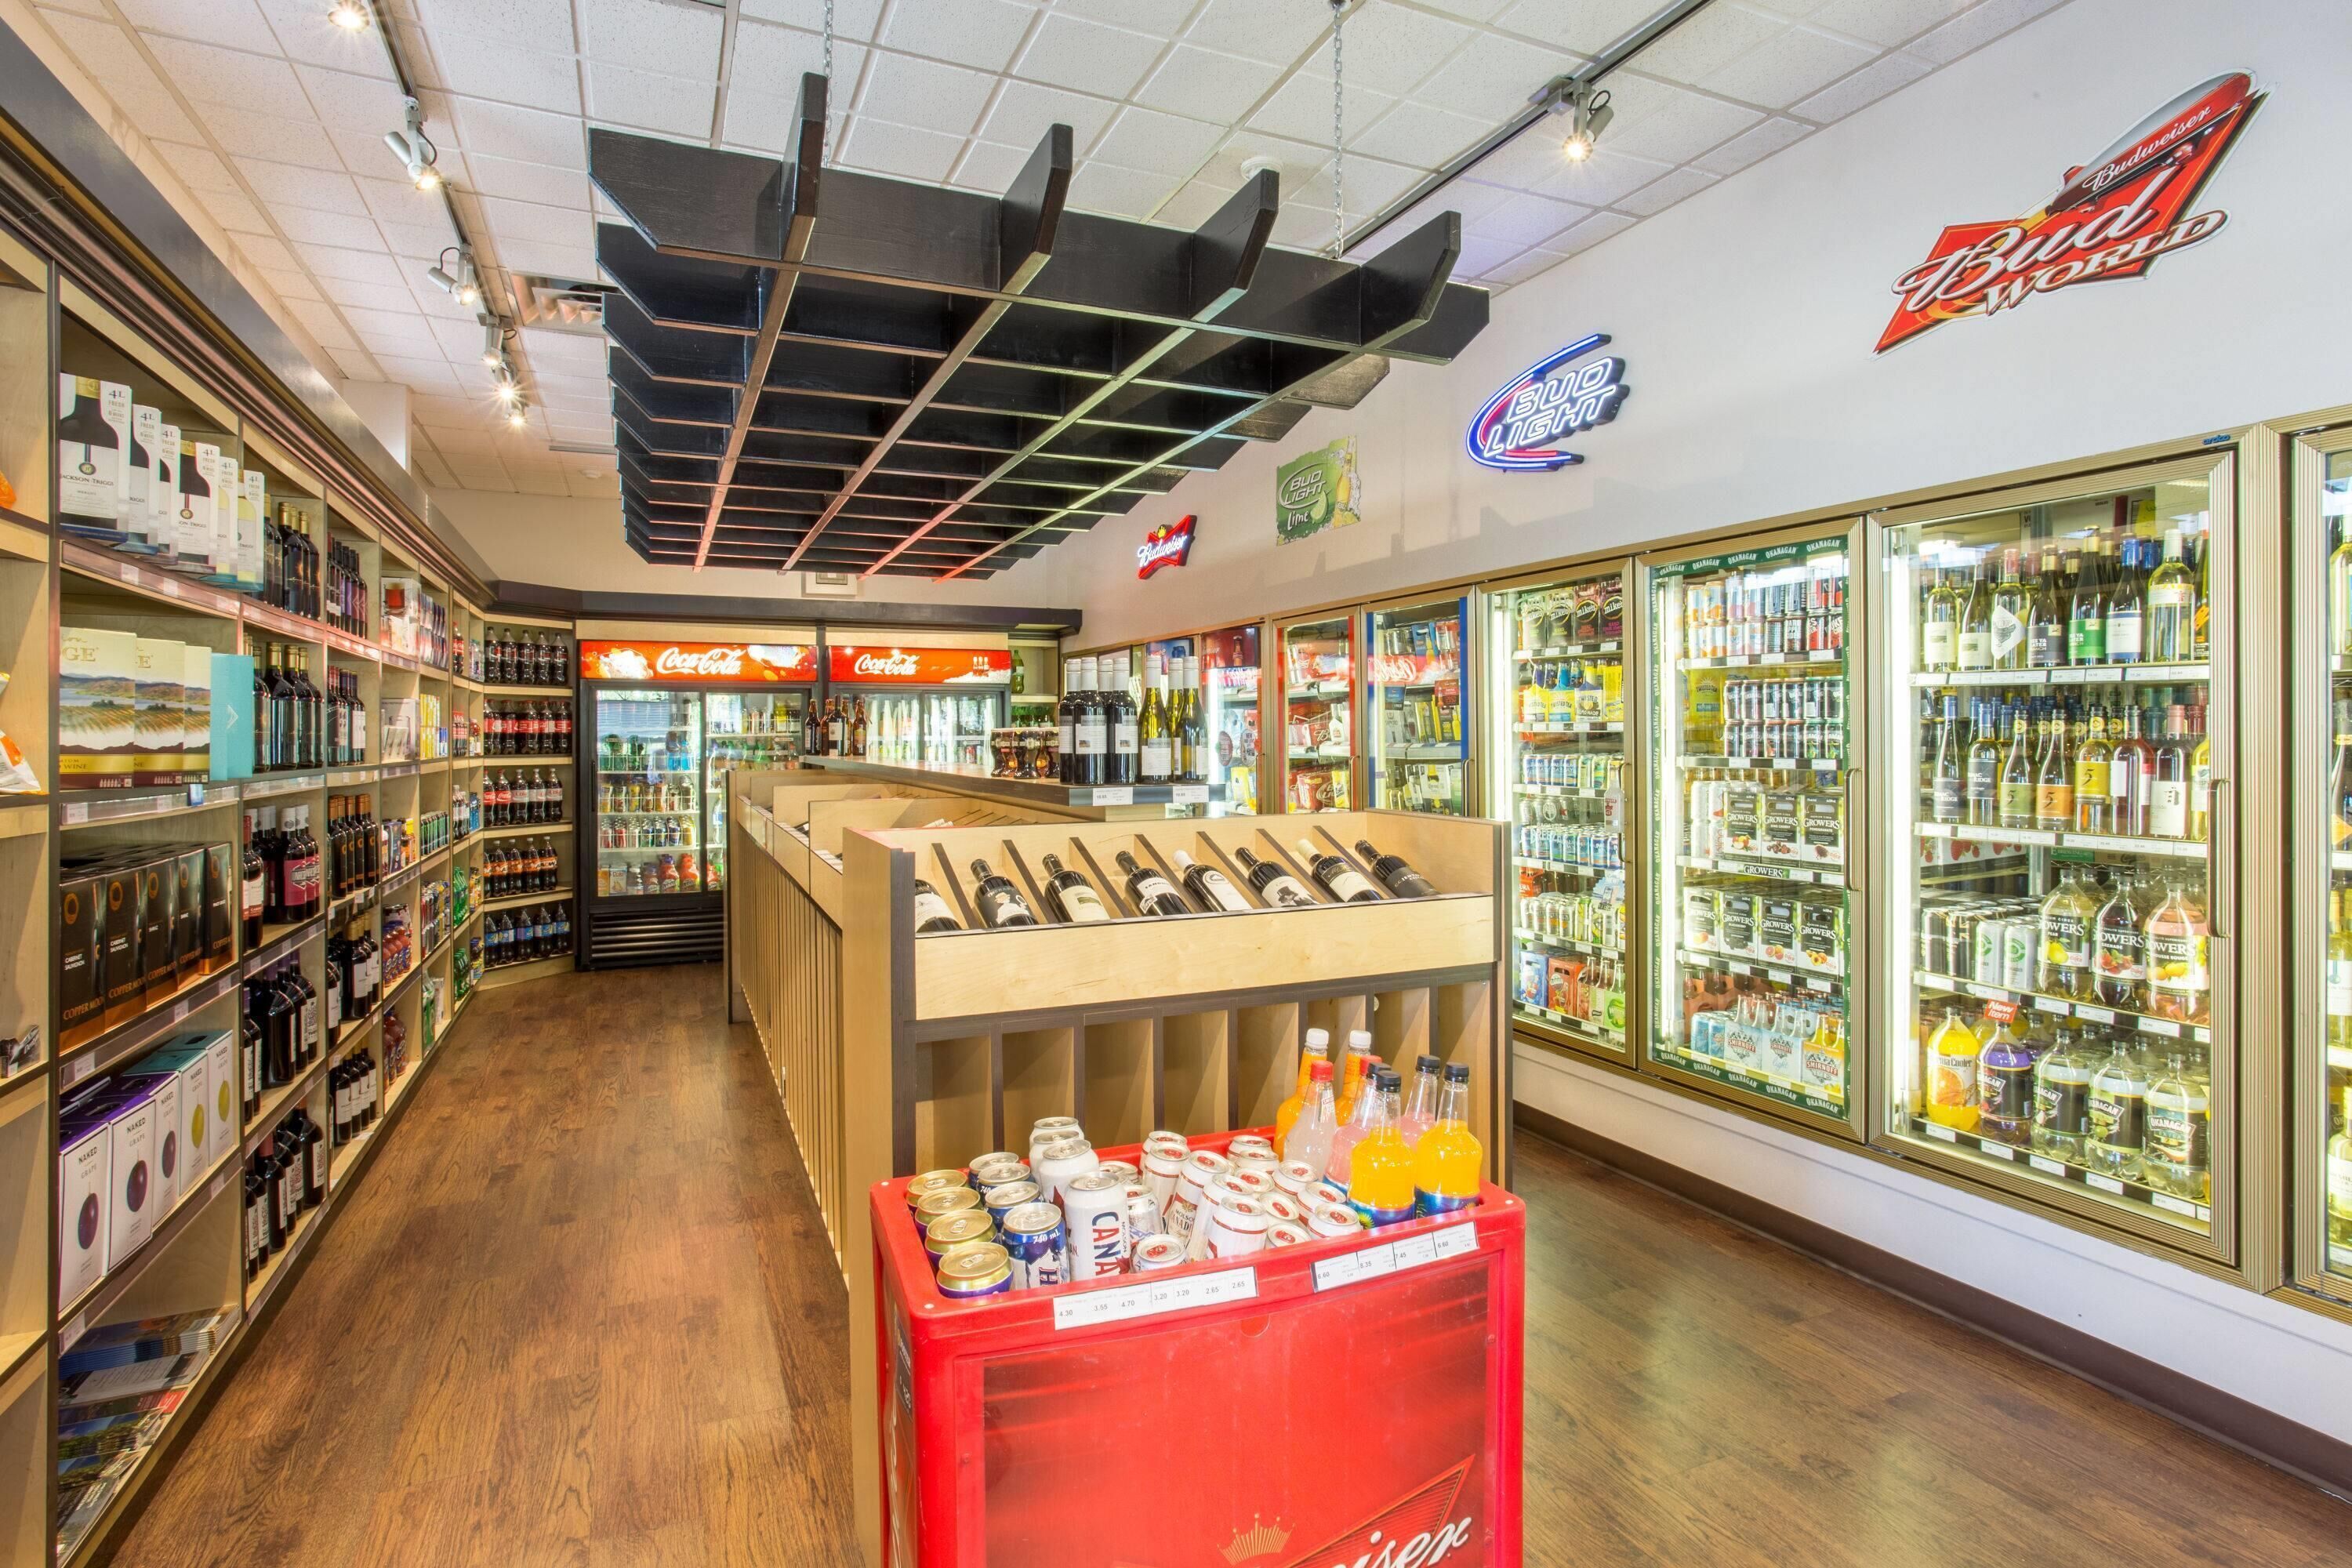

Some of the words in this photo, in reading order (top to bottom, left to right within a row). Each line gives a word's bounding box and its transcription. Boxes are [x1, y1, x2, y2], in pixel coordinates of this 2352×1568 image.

[2082, 105, 2212, 191] Budweiser
[1890, 165, 2186, 312] Bud
[1983, 210, 2228, 316] WORLD
[108, 390, 125, 399] 4L
[1506, 357, 1613, 423] BUD
[140, 412, 155, 421] 4L
[1483, 384, 1617, 457] LIGHT
[162, 430, 176, 438] 4L
[1289, 470, 1323, 488] BUD
[1283, 479, 1328, 506] LIGHT
[1287, 510, 1310, 532] lime
[1137, 535, 1189, 567] Budweiser
[1766, 546, 1797, 559] OKANAGAN
[1806, 539, 1840, 552] OKANAGAN
[1692, 559, 1720, 570] OKANAGAN
[1727, 553, 1757, 565] OKANAGAN
[1659, 564, 1685, 576] OKANAGAN
[1576, 604, 1596, 618] mike's
[656, 647, 747, 675] Coca-Cola
[855, 652, 920, 676] Coca-Cola
[2083, 768, 2095, 786] 5
[2006, 789, 2017, 805] 5
[2044, 791, 2055, 808] 5
[1726, 812, 1758, 824] GROWERS
[1765, 815, 1798, 826] GROWERS
[1803, 818, 1840, 829] GROWERS
[1744, 865, 1783, 878] GROWERS
[1722, 913, 1755, 927] GROWERS
[1760, 919, 1795, 932] GROWERS
[1799, 925, 1836, 940] GROWERS
[2094, 931, 2145, 948] OWERS
[2147, 938, 2196, 956] OWERS
[64, 953, 82, 964] CABERNET
[108, 982, 132, 998] COPPER
[64, 1003, 89, 1020] COPPER
[1988, 1000, 2013, 1012] New
[1728, 1038, 1756, 1053] SMIRNOFF
[1770, 1043, 1792, 1054] SMIRNOFF
[1661, 1052, 1686, 1066] OKANAGAN
[1951, 1058, 1973, 1068] Cooler
[191, 1068, 202, 1080] NAKED
[1693, 1062, 1720, 1077] OKANAGAN
[1806, 1060, 1838, 1076] SMIRNOFF
[1728, 1073, 1758, 1088] OKANAGAN
[161, 1091, 174, 1105] NAKED
[1766, 1085, 1797, 1101] OKANAGAN
[1806, 1098, 1838, 1114] OKANAGAN
[126, 1117, 146, 1134] NAKED
[129, 1133, 145, 1148] GRAPE
[78, 1146, 98, 1165] NAKED
[81, 1163, 97, 1179] GRAPE
[1033, 1235, 1047, 1244] 740
[1091, 1211, 1122, 1276] CANA
[1317, 1271, 1330, 1279] 6.60
[1205, 1286, 1219, 1294] 2.65
[1232, 1280, 1245, 1289] 2.65
[1153, 1292, 1167, 1301] 3.20
[1176, 1289, 1189, 1298] 3.20
[1121, 1299, 1135, 1308] 4.70
